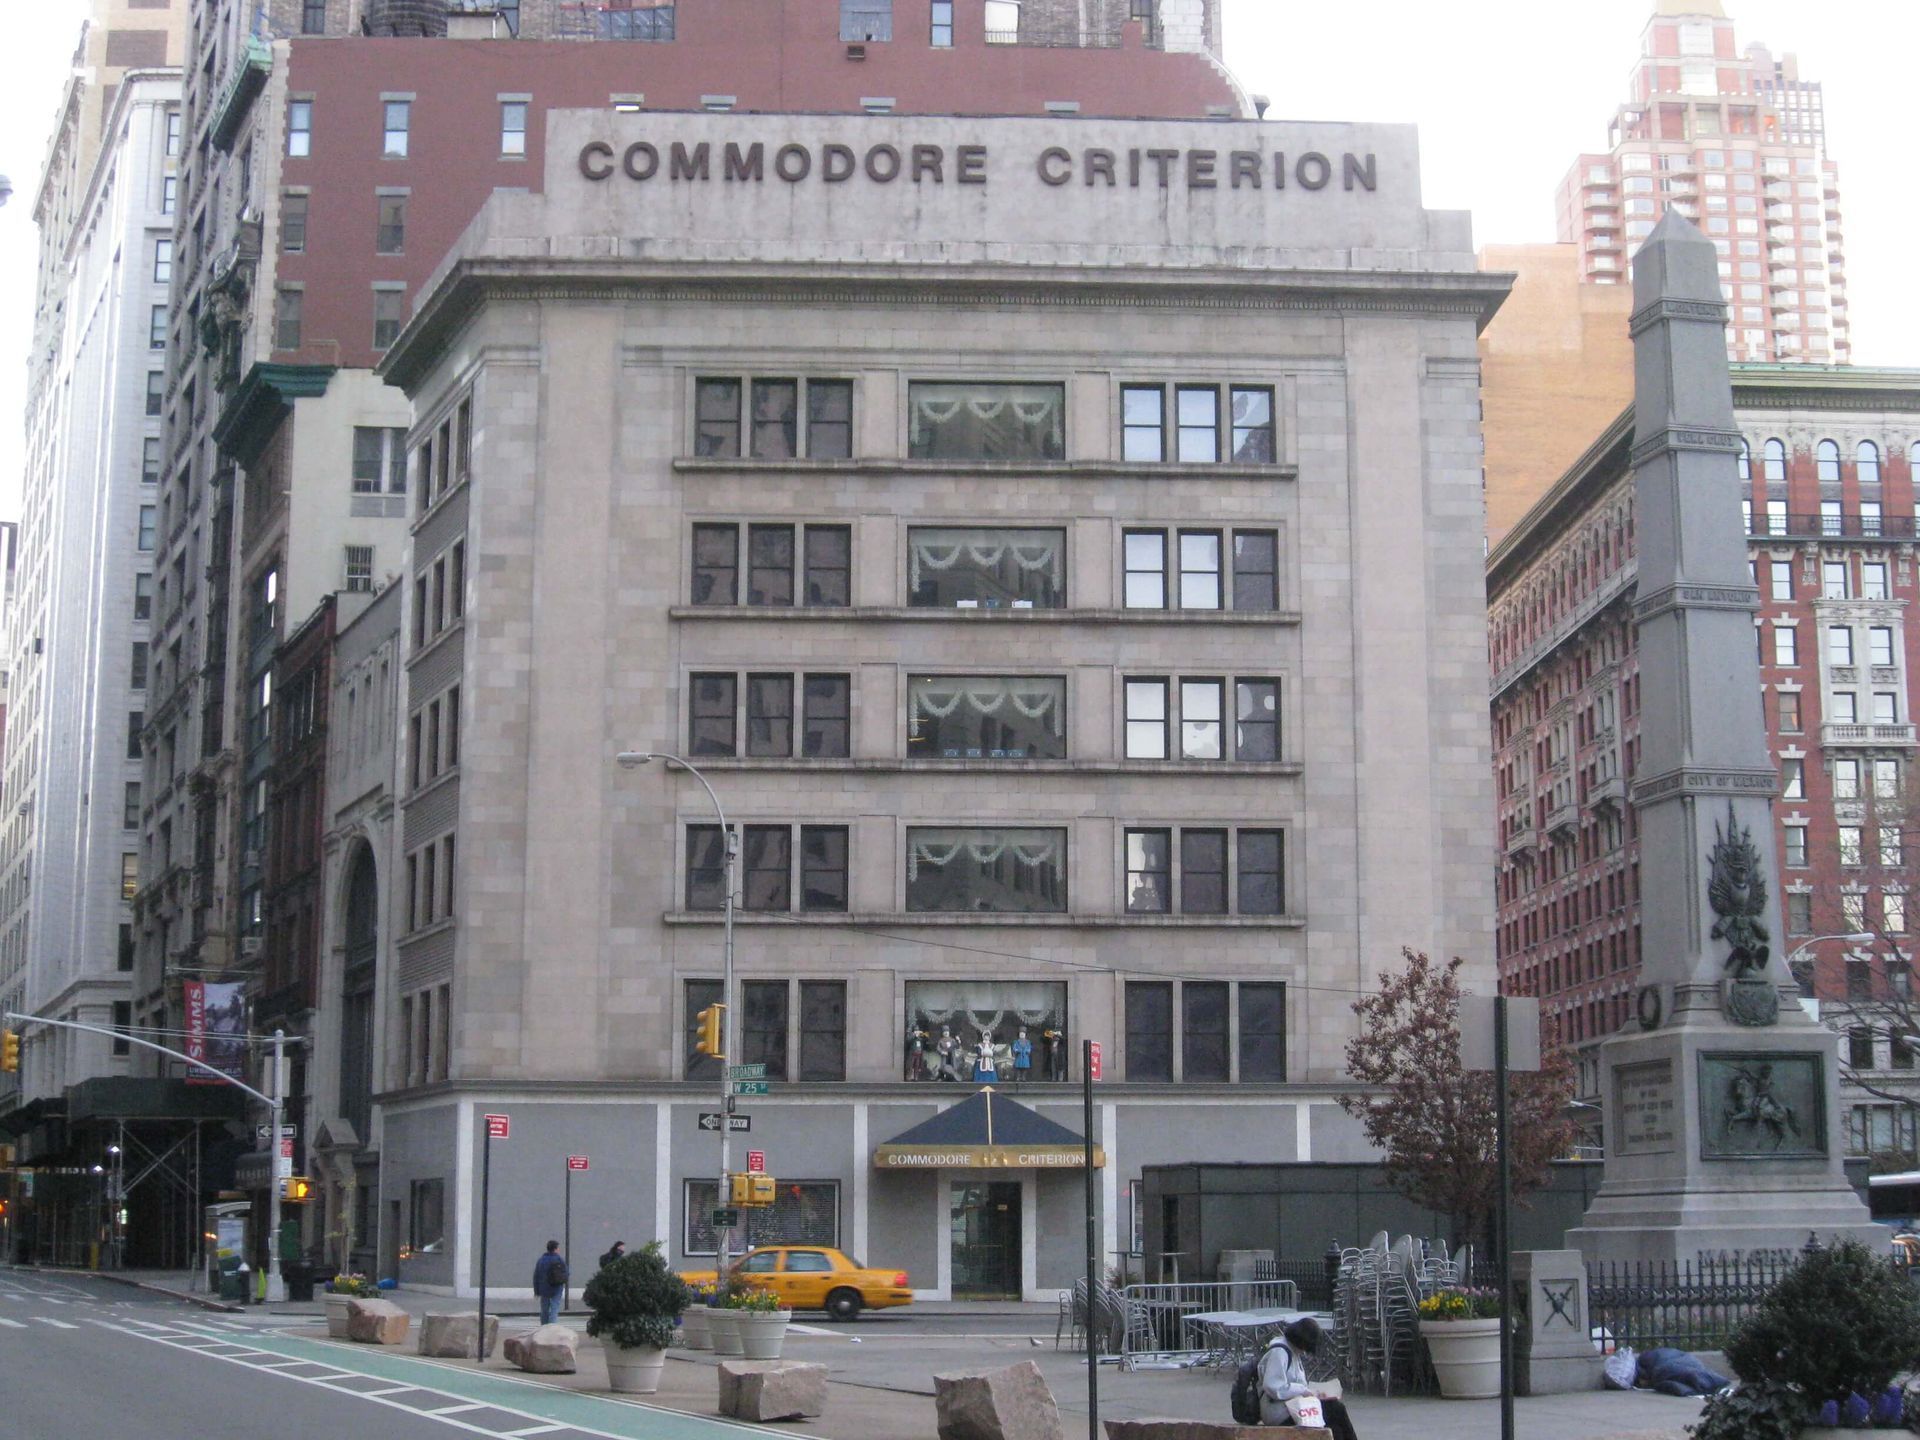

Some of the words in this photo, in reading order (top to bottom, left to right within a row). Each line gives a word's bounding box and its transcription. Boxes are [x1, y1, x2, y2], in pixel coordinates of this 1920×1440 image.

[578, 141, 987, 183] COMMODORE
[1037, 146, 1376, 191] CRITERION
[190, 987, 202, 1058] SIMMS
[731, 1065, 764, 1078] BROADWAY
[734, 1083, 742, 1093] W
[745, 1083, 757, 1093] 25
[888, 1153, 971, 1165] COMMODORE
[1018, 1153, 1085, 1165] CRITERION
[1298, 1407, 1319, 1417] CVS
